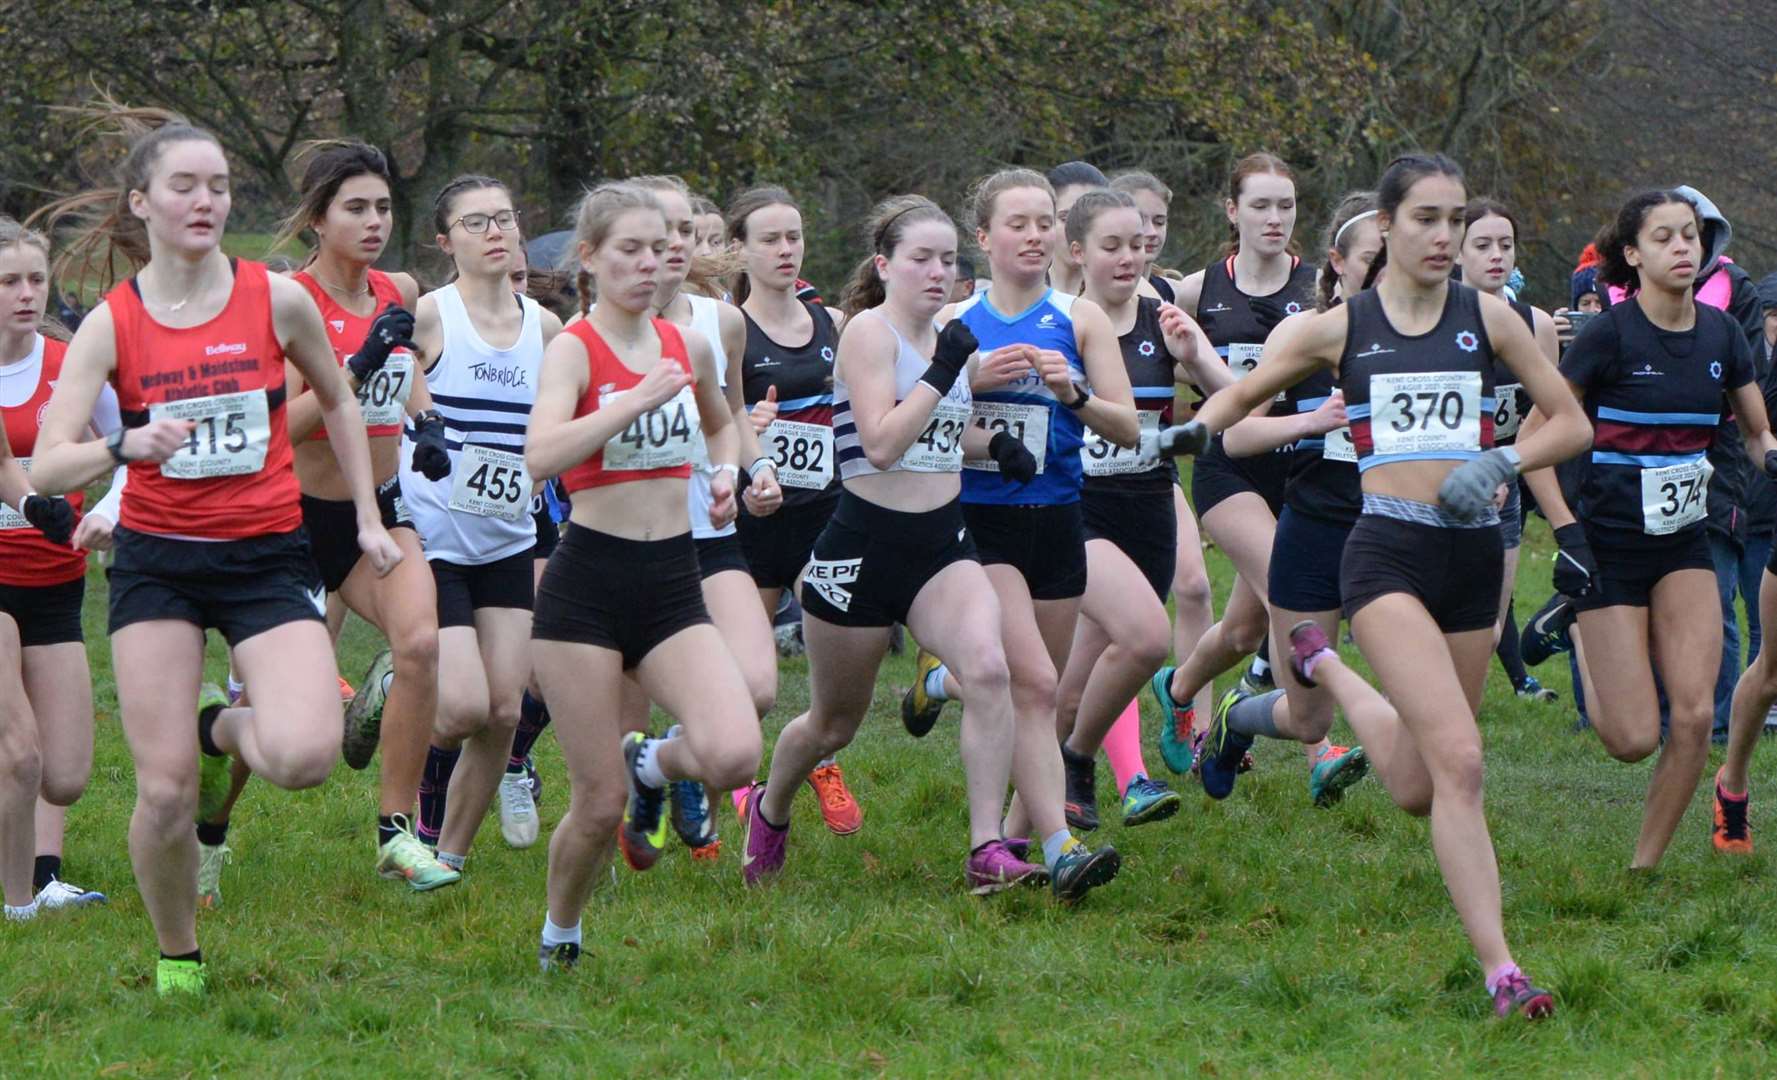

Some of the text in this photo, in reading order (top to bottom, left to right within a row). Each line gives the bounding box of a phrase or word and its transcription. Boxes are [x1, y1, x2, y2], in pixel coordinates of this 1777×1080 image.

[205, 343, 246, 355] Bellway
[141, 359, 259, 389] Medway & Maidstone
[1407, 375, 1431, 383] CROSS
[1432, 374, 1466, 383] COUNTRY
[213, 378, 240, 395] Club
[1393, 383, 1423, 391] LEAGUE
[185, 400, 213, 410] CROSS
[1390, 391, 1464, 433] 370
[620, 402, 691, 450] 404
[788, 423, 807, 432] CROSS
[1416, 434, 1447, 443] COUNTY
[769, 435, 825, 473] 382
[199, 457, 232, 467] COUNTY
[200, 463, 252, 475] ASSOCIATION
[1671, 466, 1689, 476] CROSS
[466, 463, 523, 504] 455
[1659, 474, 1704, 518] 374
